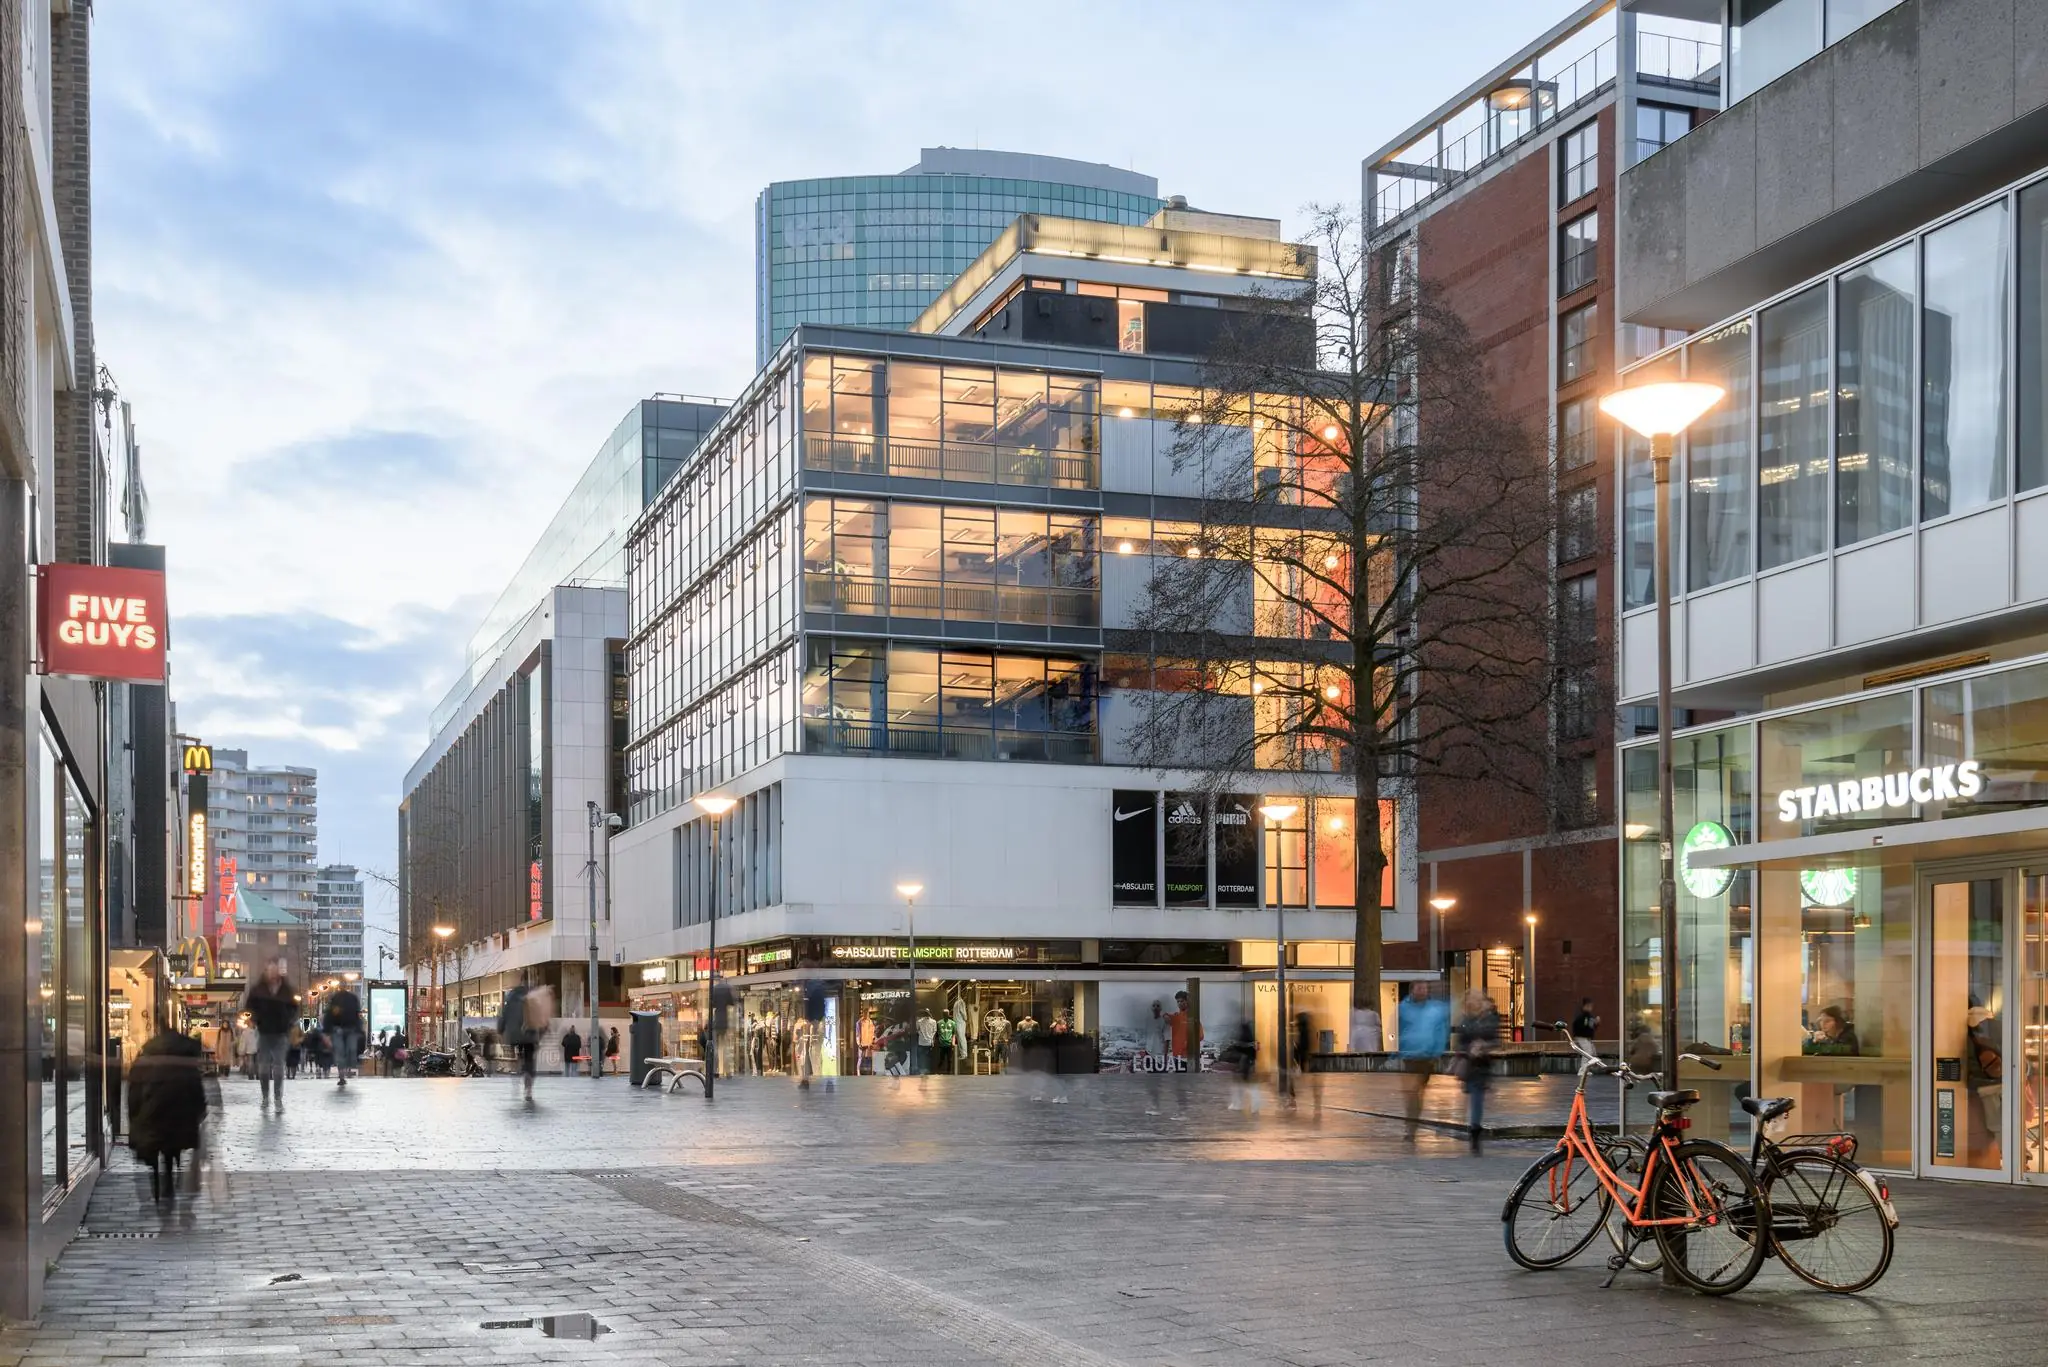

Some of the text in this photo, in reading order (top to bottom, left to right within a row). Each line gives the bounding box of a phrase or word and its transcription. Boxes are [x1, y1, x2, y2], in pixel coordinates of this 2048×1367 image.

[69, 594, 146, 622] FIVE
[59, 619, 156, 649] GUYS
[1778, 760, 1982, 822] STARBUCKS
[1168, 814, 1202, 825] adidas
[1216, 813, 1247, 825] PUMA
[191, 813, 205, 893] McDonald's
[1122, 883, 1154, 891] ABSOLUTE
[1167, 884, 1204, 892] TEAMSPORT
[1218, 885, 1255, 893] ROTTERDAM
[219, 857, 237, 934] HEMA
[956, 947, 1013, 959] ROTTERDAM
[1319, 984, 1324, 993] 1
